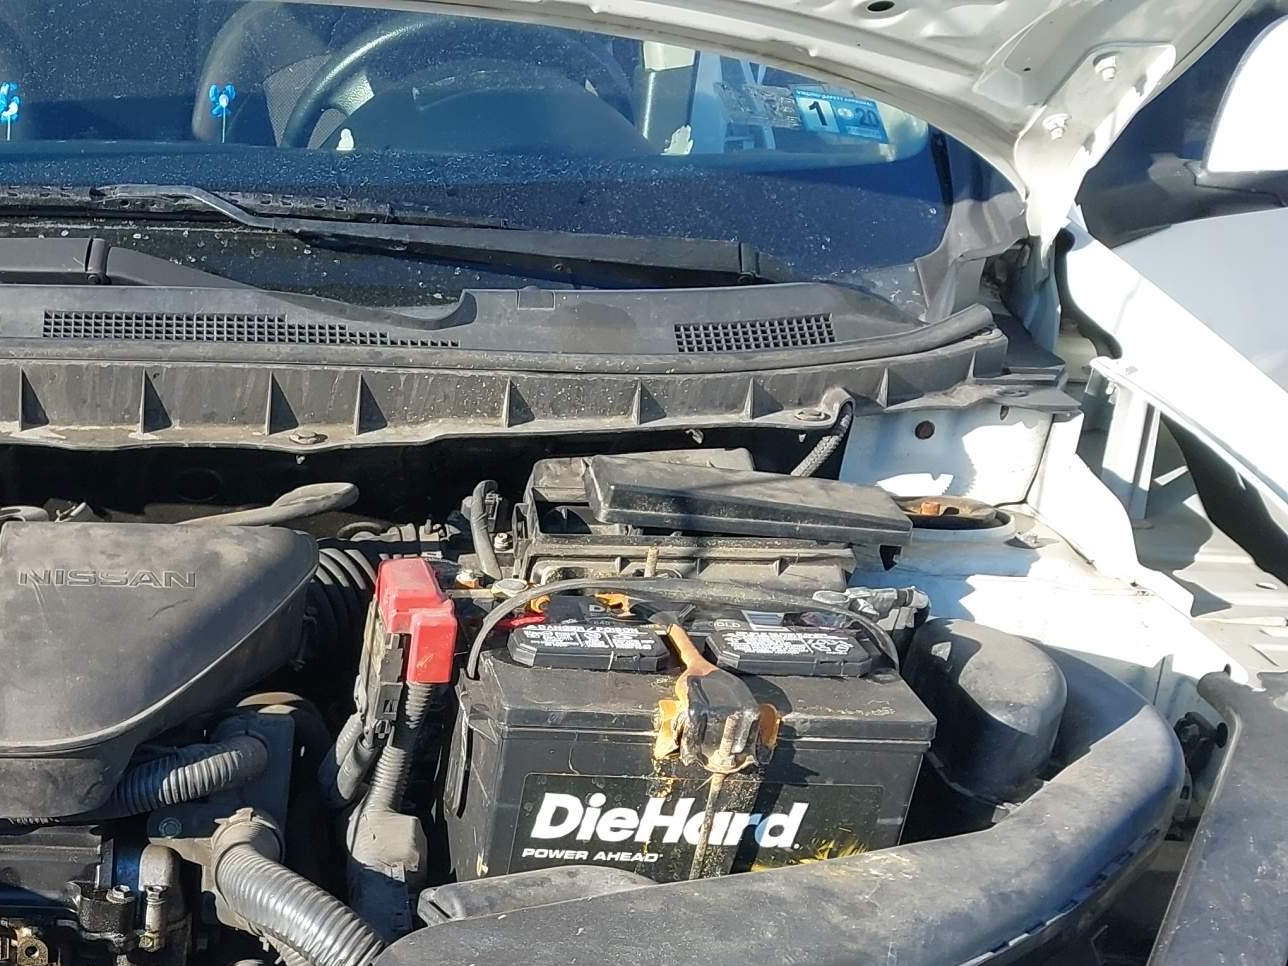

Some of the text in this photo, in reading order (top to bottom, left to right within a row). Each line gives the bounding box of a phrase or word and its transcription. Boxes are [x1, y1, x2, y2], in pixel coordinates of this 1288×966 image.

[809, 101, 828, 126] 1
[18, 569, 196, 588] NISSAN
[530, 792, 810, 848] DieHard
[522, 847, 659, 863] POWER AHEAD
